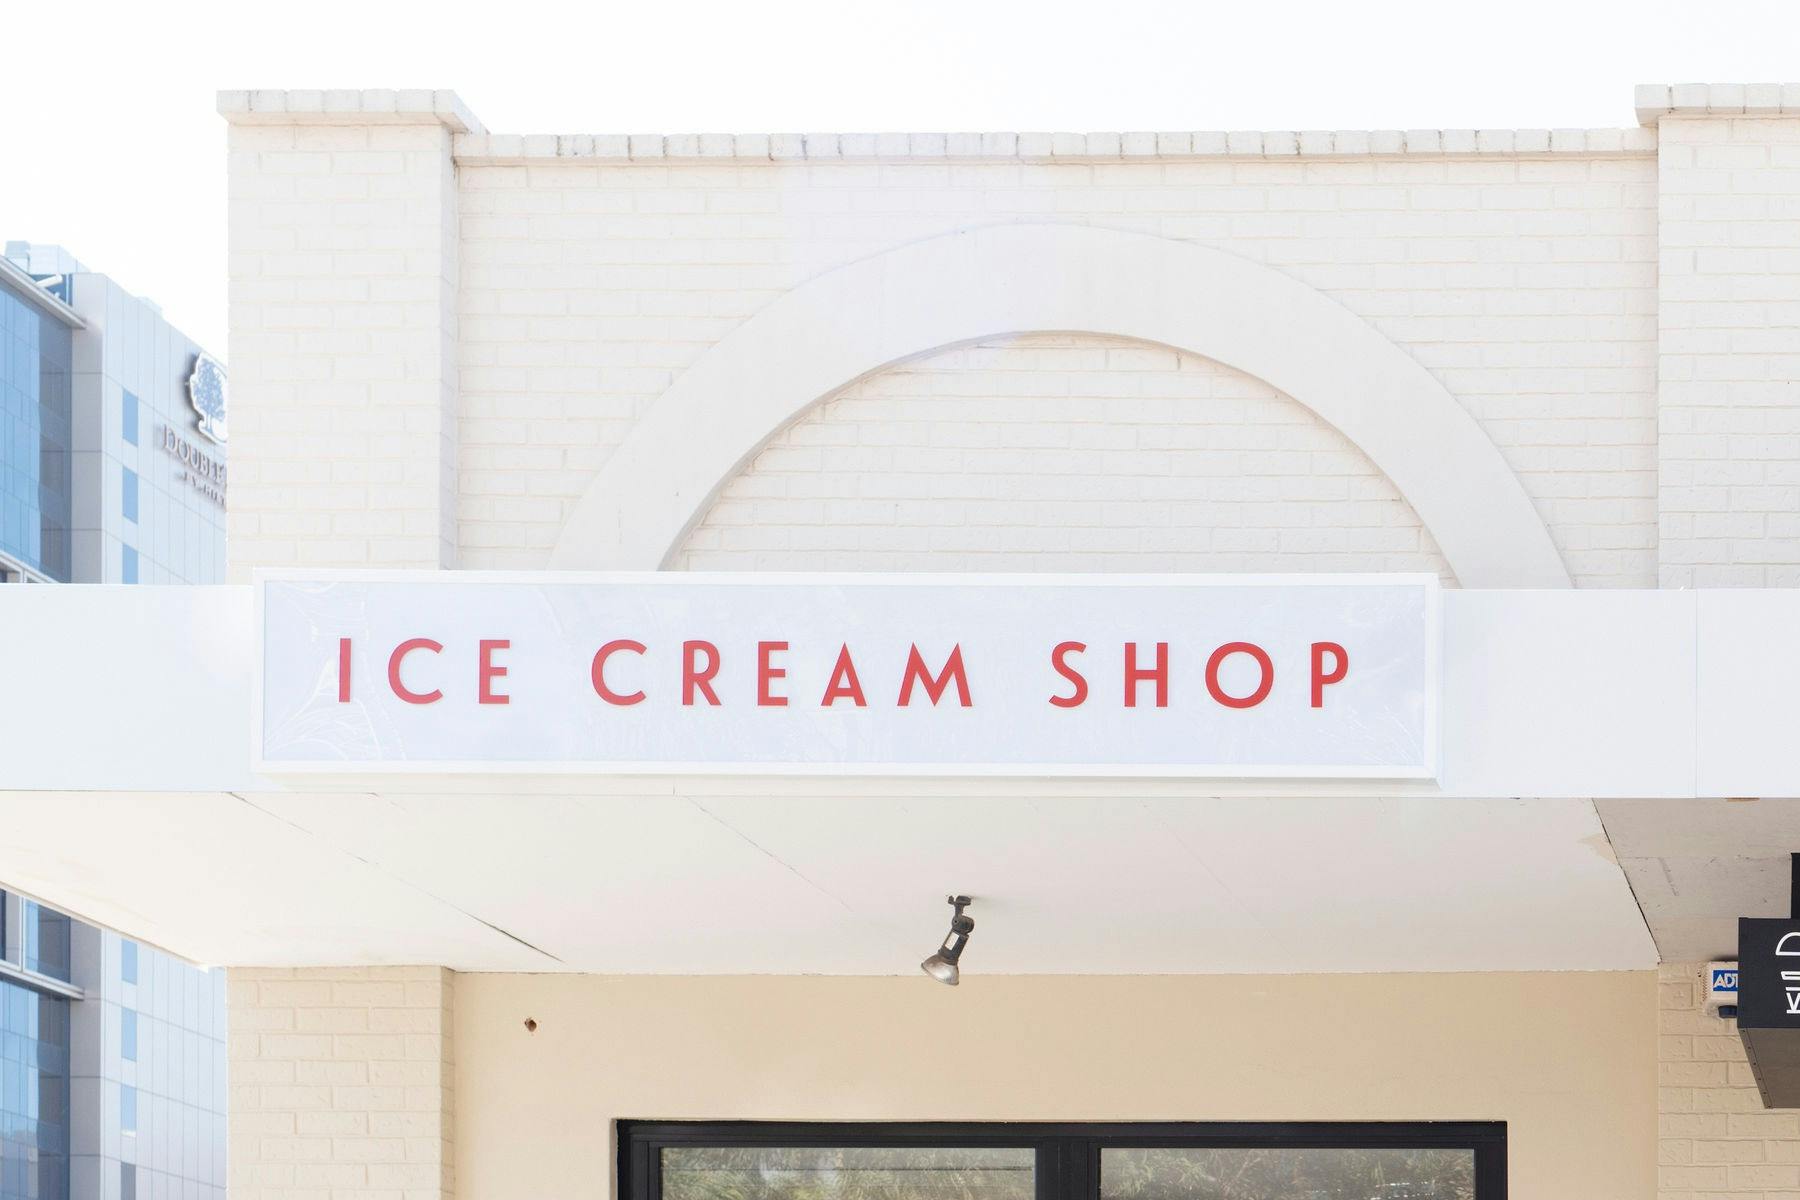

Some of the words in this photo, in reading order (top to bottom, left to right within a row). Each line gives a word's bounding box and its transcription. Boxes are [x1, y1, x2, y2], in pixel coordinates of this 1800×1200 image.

[162, 423, 227, 484] DOUBLE
[338, 637, 510, 705] ICE
[591, 639, 972, 708] CREAM
[1049, 640, 1349, 709] SHOP
